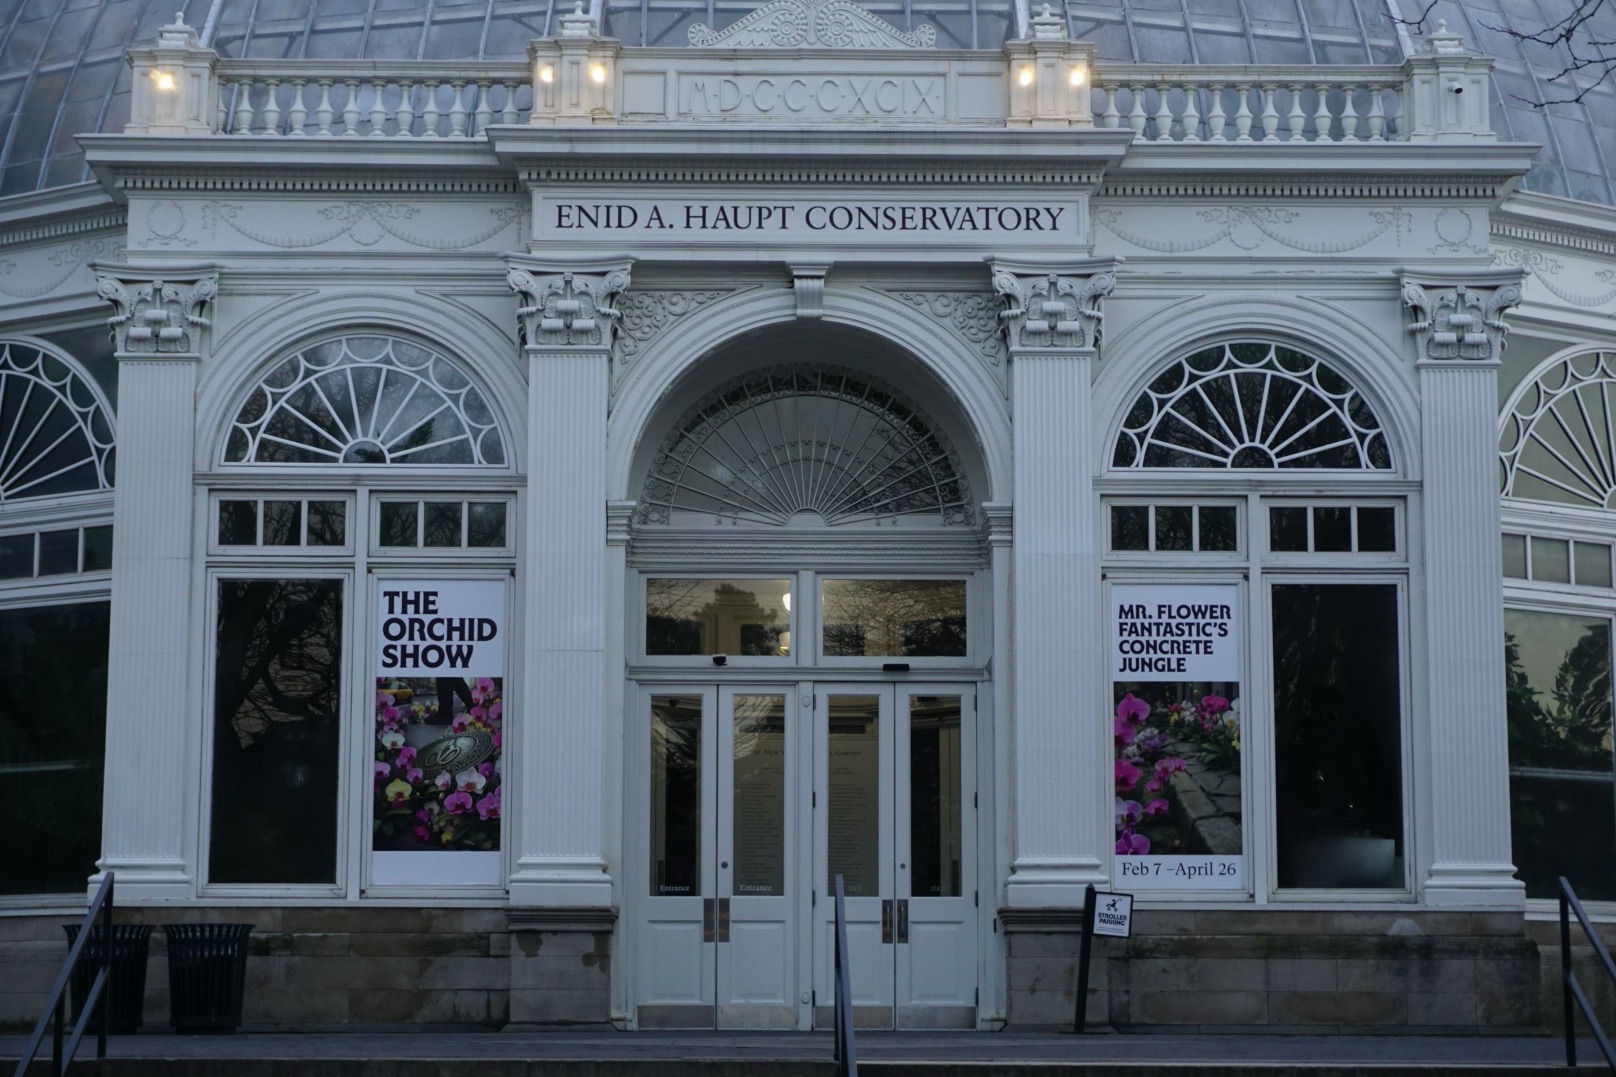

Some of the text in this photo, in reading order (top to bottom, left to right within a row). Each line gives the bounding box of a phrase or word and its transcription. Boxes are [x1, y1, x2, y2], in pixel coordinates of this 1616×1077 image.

[555, 205, 1065, 231] ENID A. HAUPT CONSERVATORY
[383, 591, 439, 615] THE
[1118, 604, 1232, 620] MR. FLOWER
[382, 617, 498, 642] ORCHID
[1118, 639, 1214, 655] CONCRETE
[382, 644, 474, 669] SHOW
[1118, 657, 1187, 673] JUNGLE
[1122, 862, 1149, 876] Feb
[1153, 862, 1162, 876] 7
[1218, 862, 1237, 876] 26
[659, 884, 690, 892] Entrance
[739, 884, 773, 892] Entrance
[1097, 912, 1127, 921] STROLLER
[1099, 917, 1125, 926] PARKING
